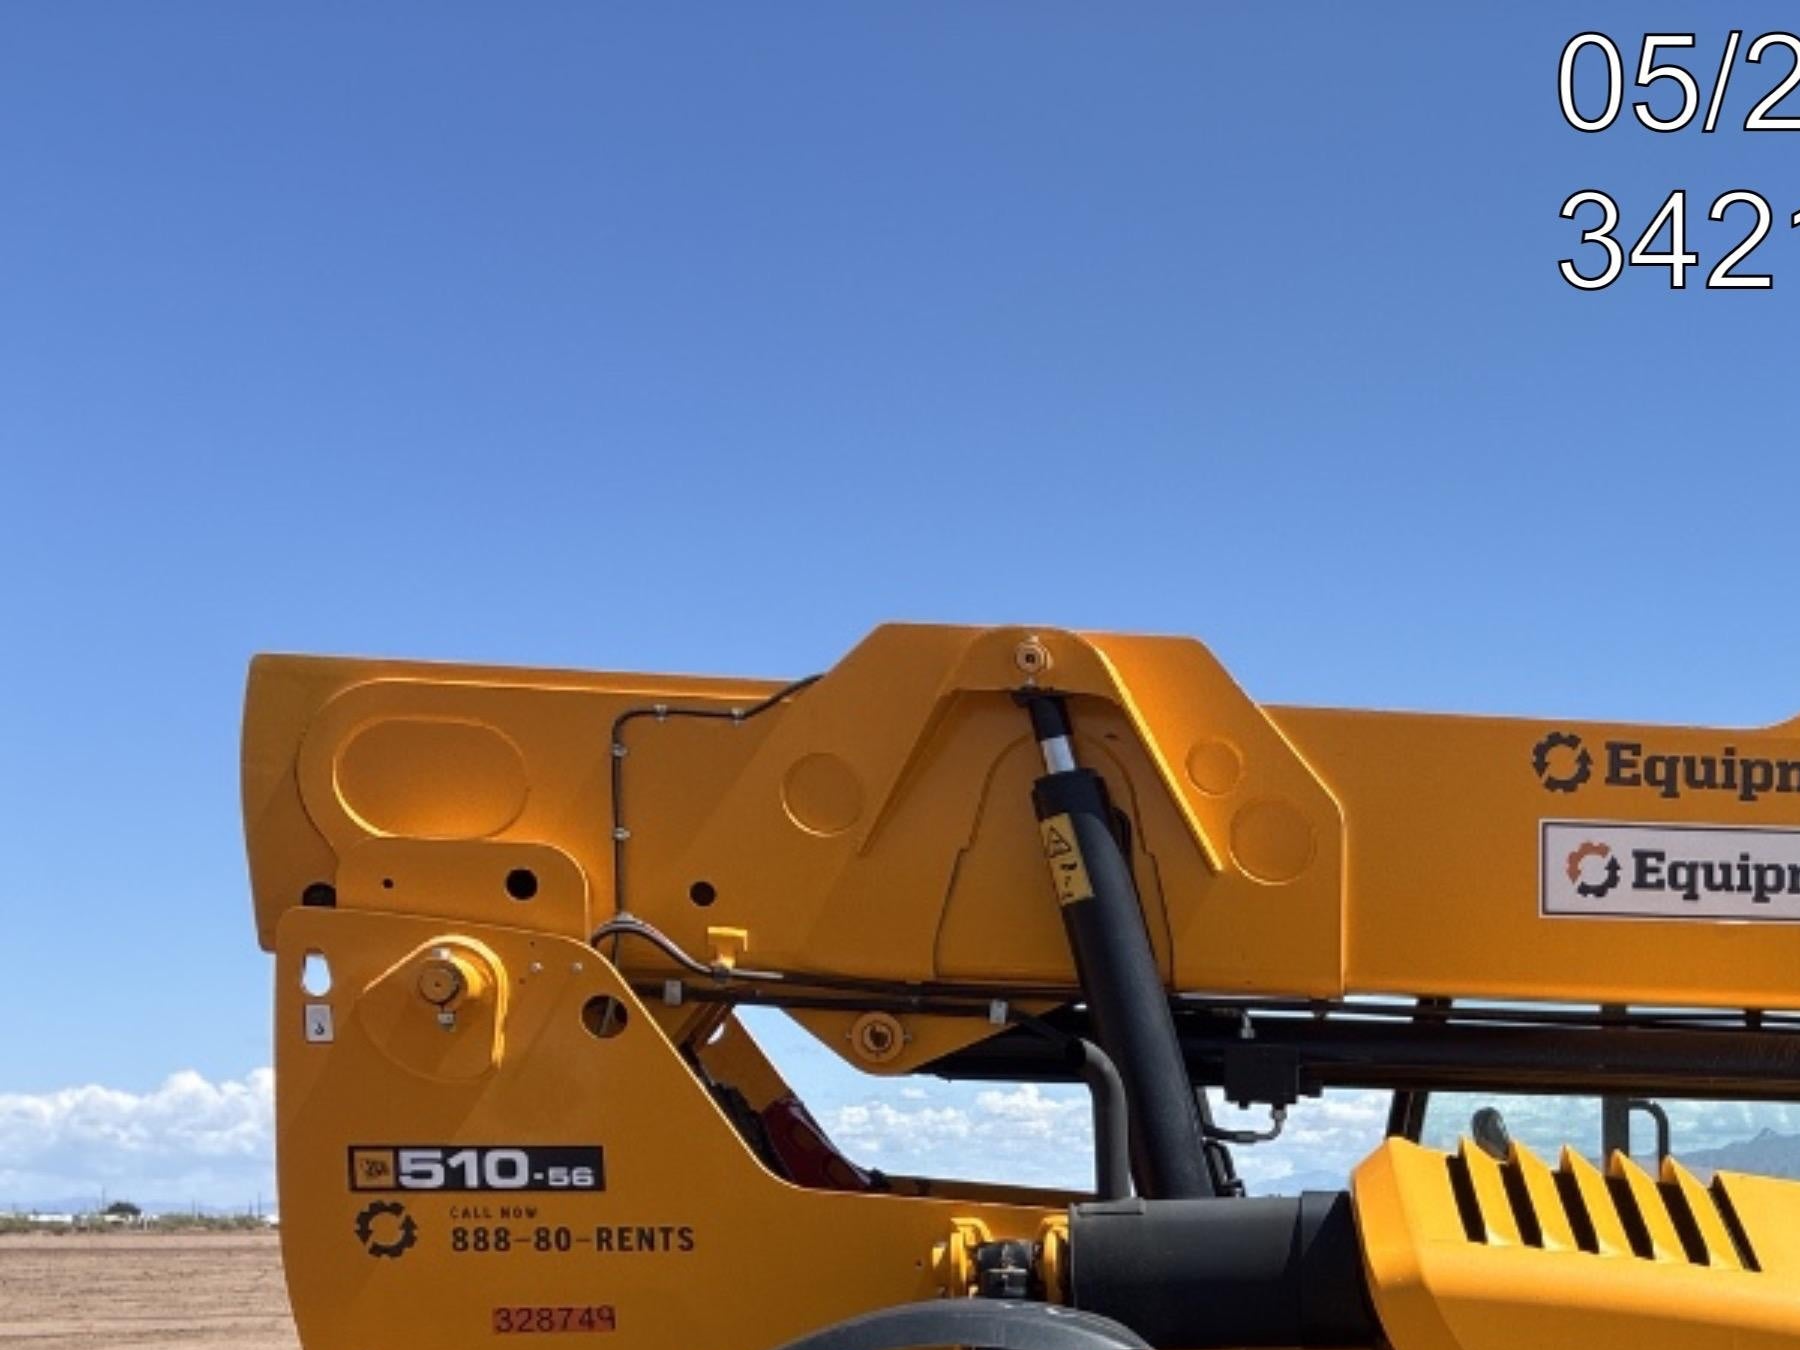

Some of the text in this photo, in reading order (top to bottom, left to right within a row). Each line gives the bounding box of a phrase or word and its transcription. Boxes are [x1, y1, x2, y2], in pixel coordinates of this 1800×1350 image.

[398, 1148, 595, 1190] 510-56
[450, 1205, 538, 1219] CALL NOW
[451, 1226, 695, 1252] 888-80-RENTS
[495, 1306, 616, 1333] 328749
